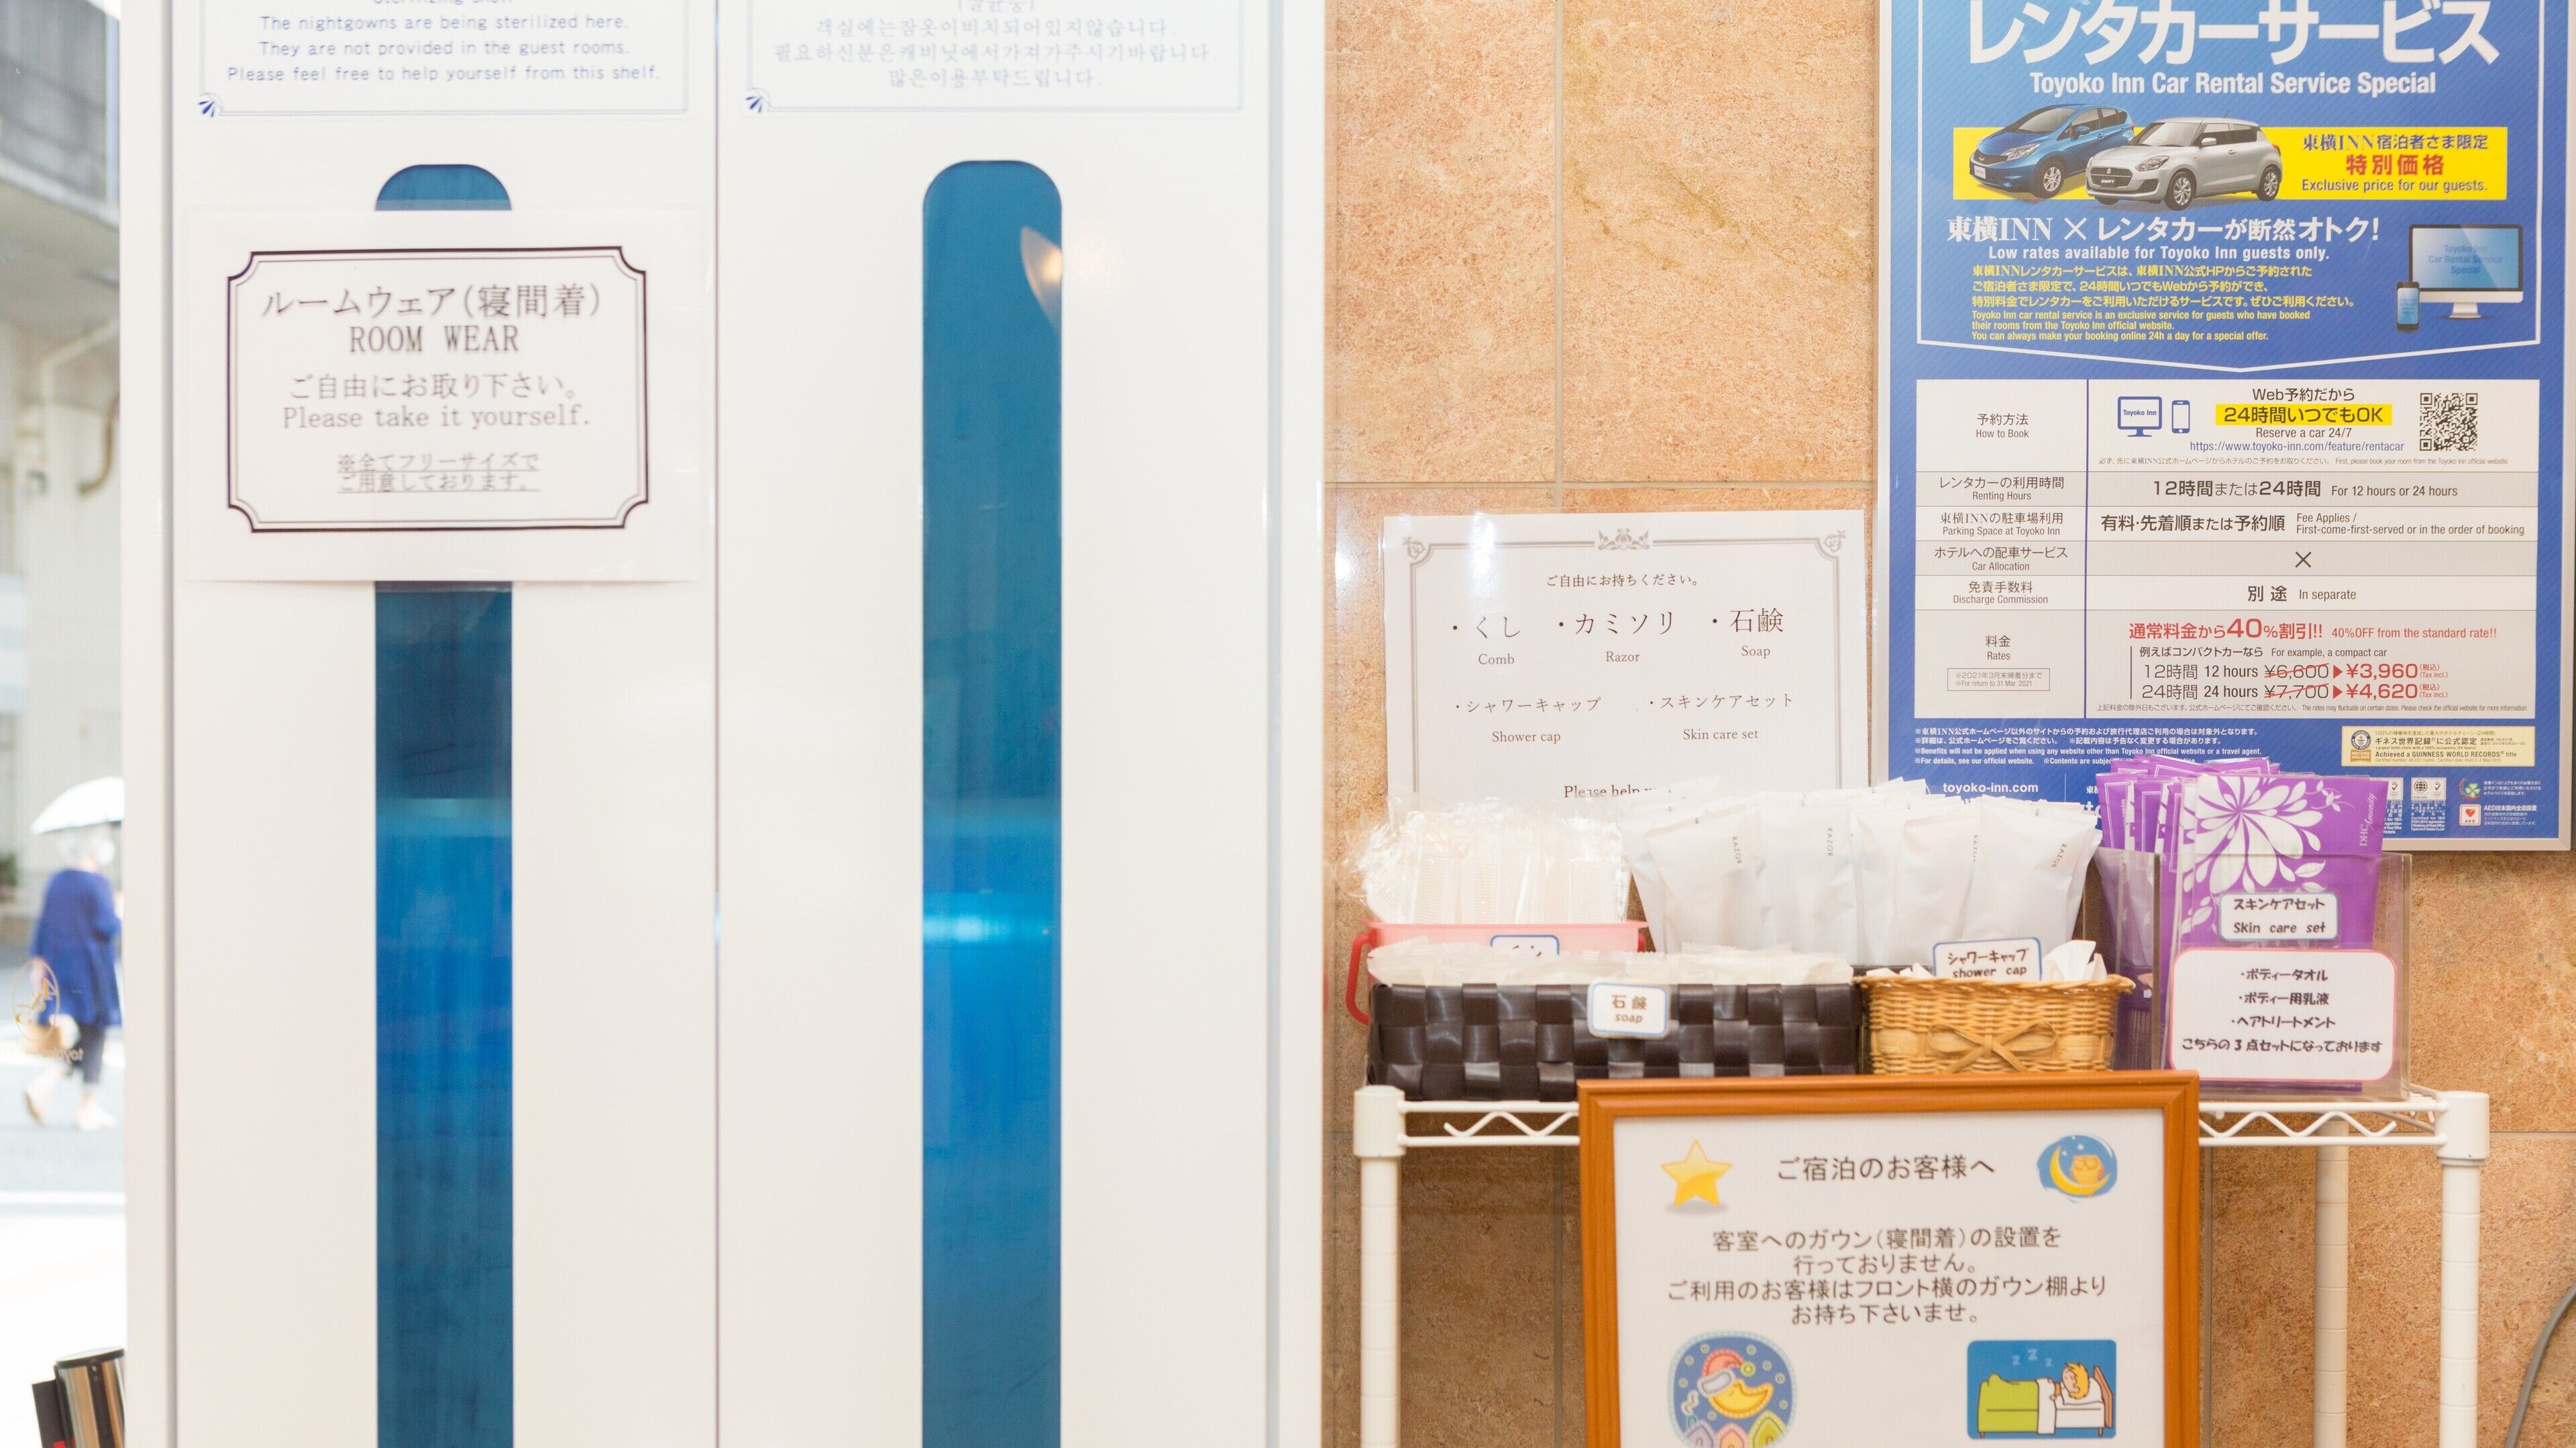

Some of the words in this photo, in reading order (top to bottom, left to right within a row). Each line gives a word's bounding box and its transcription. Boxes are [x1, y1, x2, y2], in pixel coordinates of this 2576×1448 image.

[260, 15, 290, 30] The
[299, 17, 396, 32] nightgowns
[405, 19, 432, 29] are
[441, 17, 486, 30] being
[496, 16, 577, 32] sterilized
[586, 16, 627, 28] here.
[1970, 0, 2500, 65] レンタカーサービス
[2030, 72, 2104, 97] Toyoko
[2112, 72, 2145, 93] Inn
[2152, 72, 2189, 93] Car
[2196, 72, 2263, 93] Rental
[2271, 72, 2351, 93] Service
[2357, 72, 2435, 98] Special
[2302, 178, 2359, 190] Exclusive
[2363, 179, 2394, 193] price
[2398, 179, 2414, 190] for
[2419, 182, 2438, 190] our
[2443, 180, 2487, 193] guests.
[1947, 216, 2053, 242] 東横INN
[1989, 246, 2017, 259] Low
[2023, 247, 2059, 259] rates
[2065, 246, 2129, 259] available
[2135, 246, 2155, 259] for
[2160, 246, 2209, 261] Toyoko
[2216, 246, 2237, 258] Inn
[2243, 247, 2290, 262] guests
[2296, 246, 2328, 262] only.
[1972, 320, 1991, 329] their
[2023, 321, 2042, 329] from
[2045, 321, 2058, 329] the
[2061, 321, 2090, 331] Toyoko
[2092, 321, 2105, 329] Inn
[2108, 321, 2136, 329] official
[2139, 321, 2174, 329] website.
[350, 326, 423, 353] ROOM
[444, 325, 518, 351] WEAR
[2253, 388, 2354, 401] Web予約だから
[284, 406, 362, 428] Please
[375, 405, 429, 427] take
[441, 406, 460, 427] it
[472, 404, 588, 429] yourself.
[1977, 413, 2028, 425] 予約方法
[2224, 406, 2383, 423] 24時間いつでもOK
[1976, 429, 1994, 437] How
[2008, 429, 2029, 437] Book
[2256, 428, 2296, 437] Reserve
[2328, 428, 2352, 438] 24/7
[2190, 441, 2404, 453] https://www.toyoko-inn.com/feature/rentacar
[1941, 477, 2063, 489] レンタカーの利用時間
[2154, 480, 2320, 496] 12時間または24時間
[2332, 486, 2348, 496] For
[2352, 486, 2363, 496] 12
[2367, 486, 2396, 496] hours
[2413, 486, 2425, 496] 24
[2429, 486, 2457, 496] hours
[1973, 492, 2004, 502] Renting
[2007, 492, 2031, 500] Hours
[1935, 547, 2068, 559] ホテルへの配車サービス
[1972, 562, 1986, 570] Car
[1989, 562, 2029, 570] Allocation
[1969, 581, 2033, 593] 免責手数料
[1953, 595, 1994, 605] Discharge
[1998, 595, 2048, 604] Commission
[2300, 590, 2308, 599] In
[2312, 590, 2356, 602] separate
[2331, 628, 2374, 639] 40%OFF
[2377, 628, 2400, 638] from
[2404, 626, 2419, 638] the
[2423, 626, 2466, 638] standard
[2470, 628, 2496, 638] rate!!
[1986, 635, 2010, 647] 料金
[1606, 651, 1640, 662] Razor
[1741, 645, 1770, 659] Soap
[1988, 651, 2010, 660] Rates
[1479, 653, 1514, 665] Comb
[2145, 664, 2197, 679] 12時間
[2205, 665, 2218, 677] 12
[2224, 665, 2258, 677] hours
[2347, 663, 2418, 680] ¥3,960
[2143, 685, 2197, 700] 24時間
[2204, 685, 2219, 697] 24
[2224, 685, 2258, 698] hours
[2347, 684, 2418, 700] ¥4,620
[1493, 731, 1536, 742] Shower
[1541, 734, 1560, 744] cap
[1684, 729, 1709, 740] Skin
[1564, 785, 1607, 798] Please
[1943, 782, 2039, 794] toyoko-inn.com
[2234, 898, 2324, 910] スキンケアセット
[2234, 922, 2260, 933] Skin
[2270, 925, 2296, 933] care
[2306, 922, 2325, 932] set
[1948, 948, 2029, 965] シャワーキャップ
[1953, 968, 1996, 979] shower
[2006, 967, 2027, 975] cap
[1615, 1014, 1642, 1023] soap
[1778, 1155, 1994, 1181] ご宿泊のお客様へ
[1794, 1253, 1974, 1275] 行っておりません。
[1792, 1302, 1976, 1325] お持ち下さいませ。
